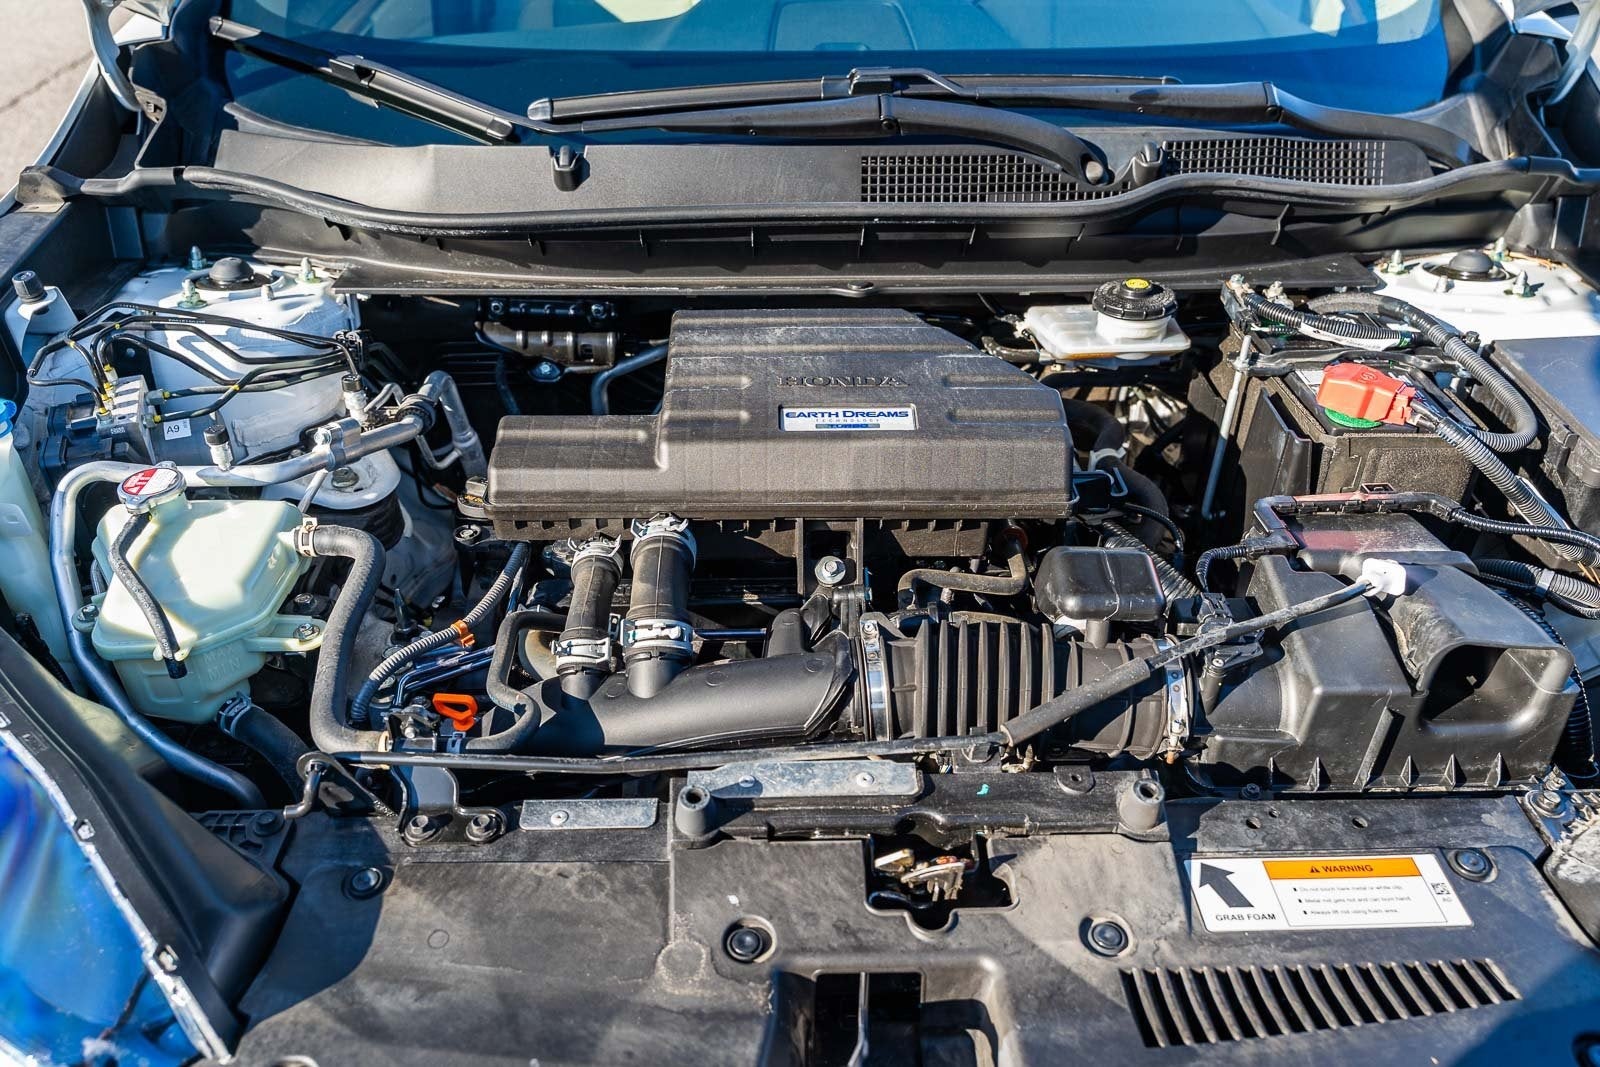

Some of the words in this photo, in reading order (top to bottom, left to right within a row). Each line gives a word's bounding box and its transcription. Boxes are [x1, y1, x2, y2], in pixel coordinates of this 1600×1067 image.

[776, 375, 911, 388] HONDA
[785, 411, 839, 419] EARTH
[842, 410, 909, 419] DREAMS
[166, 424, 180, 435] A9
[1321, 864, 1374, 874] WARNING
[1215, 913, 1245, 922] GRAB
[1246, 913, 1277, 921] FOAM
